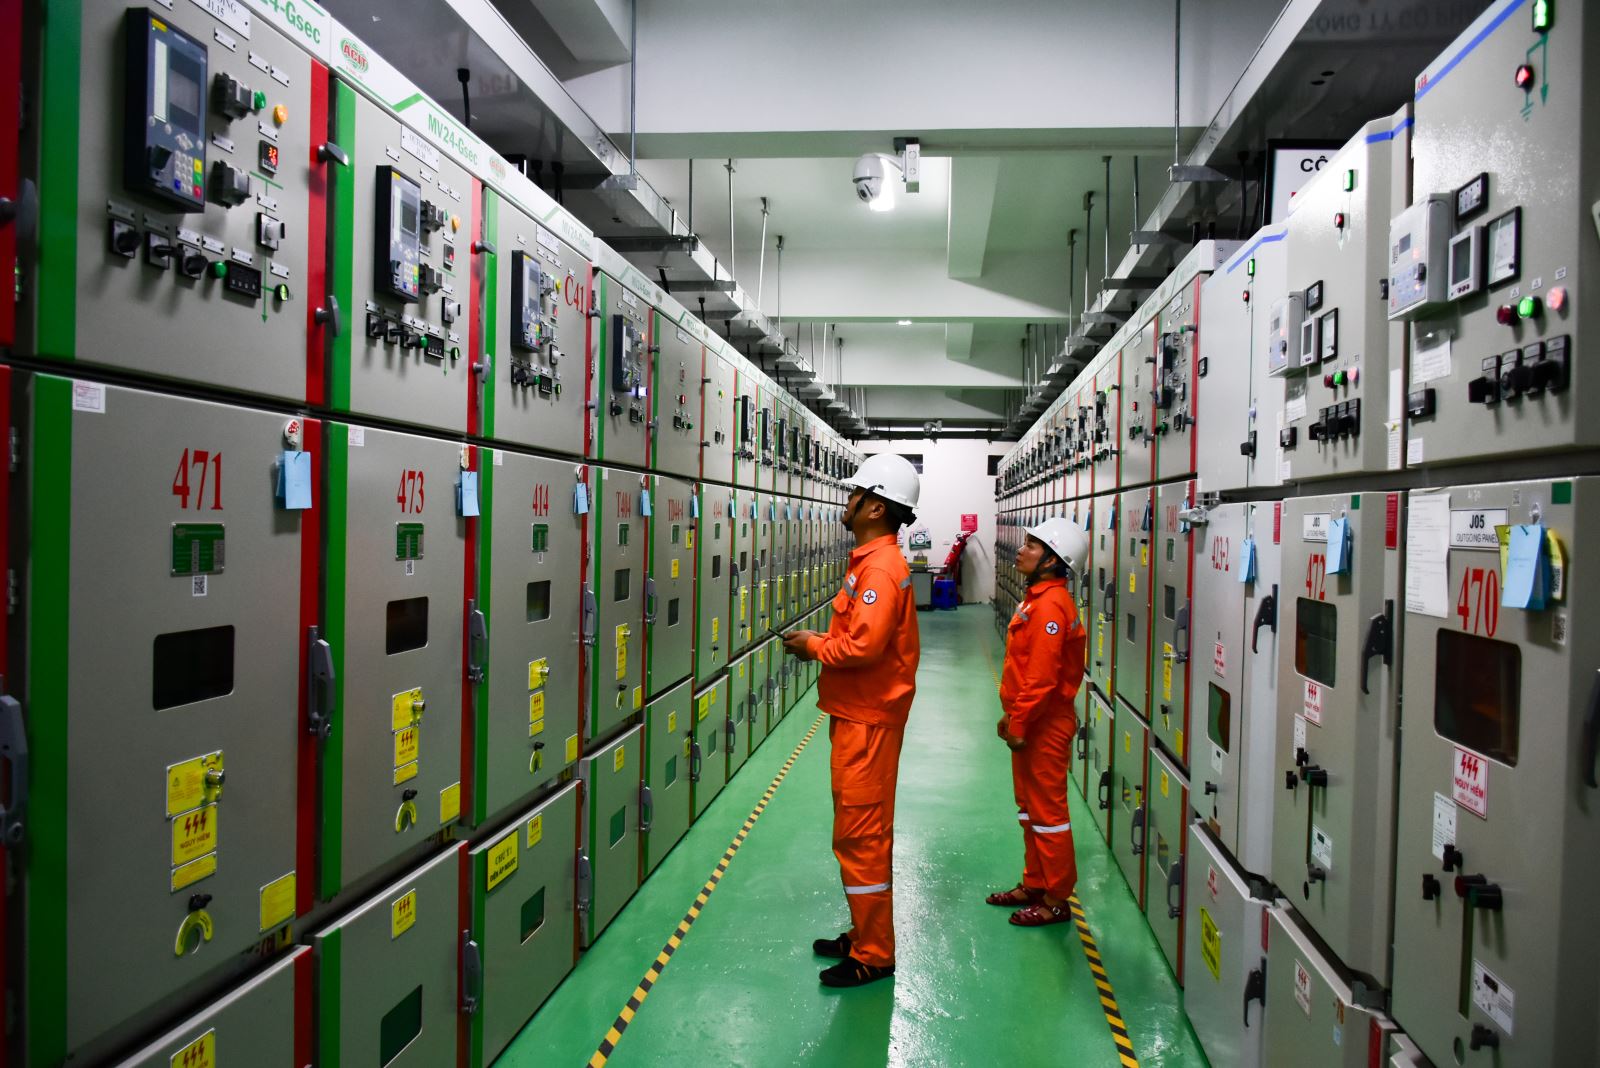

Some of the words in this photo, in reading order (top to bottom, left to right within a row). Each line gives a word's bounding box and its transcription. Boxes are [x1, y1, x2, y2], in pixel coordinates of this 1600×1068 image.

[428, 113, 478, 166] MV24-Gsec
[564, 275, 585, 315] C41
[172, 447, 224, 511] 471
[396, 468, 425, 514] 473
[532, 482, 549, 517] 414
[1456, 533, 1481, 543] OUTGOING
[1469, 514, 1485, 529] J05
[1305, 552, 1326, 601] 472
[1456, 566, 1499, 638] 470
